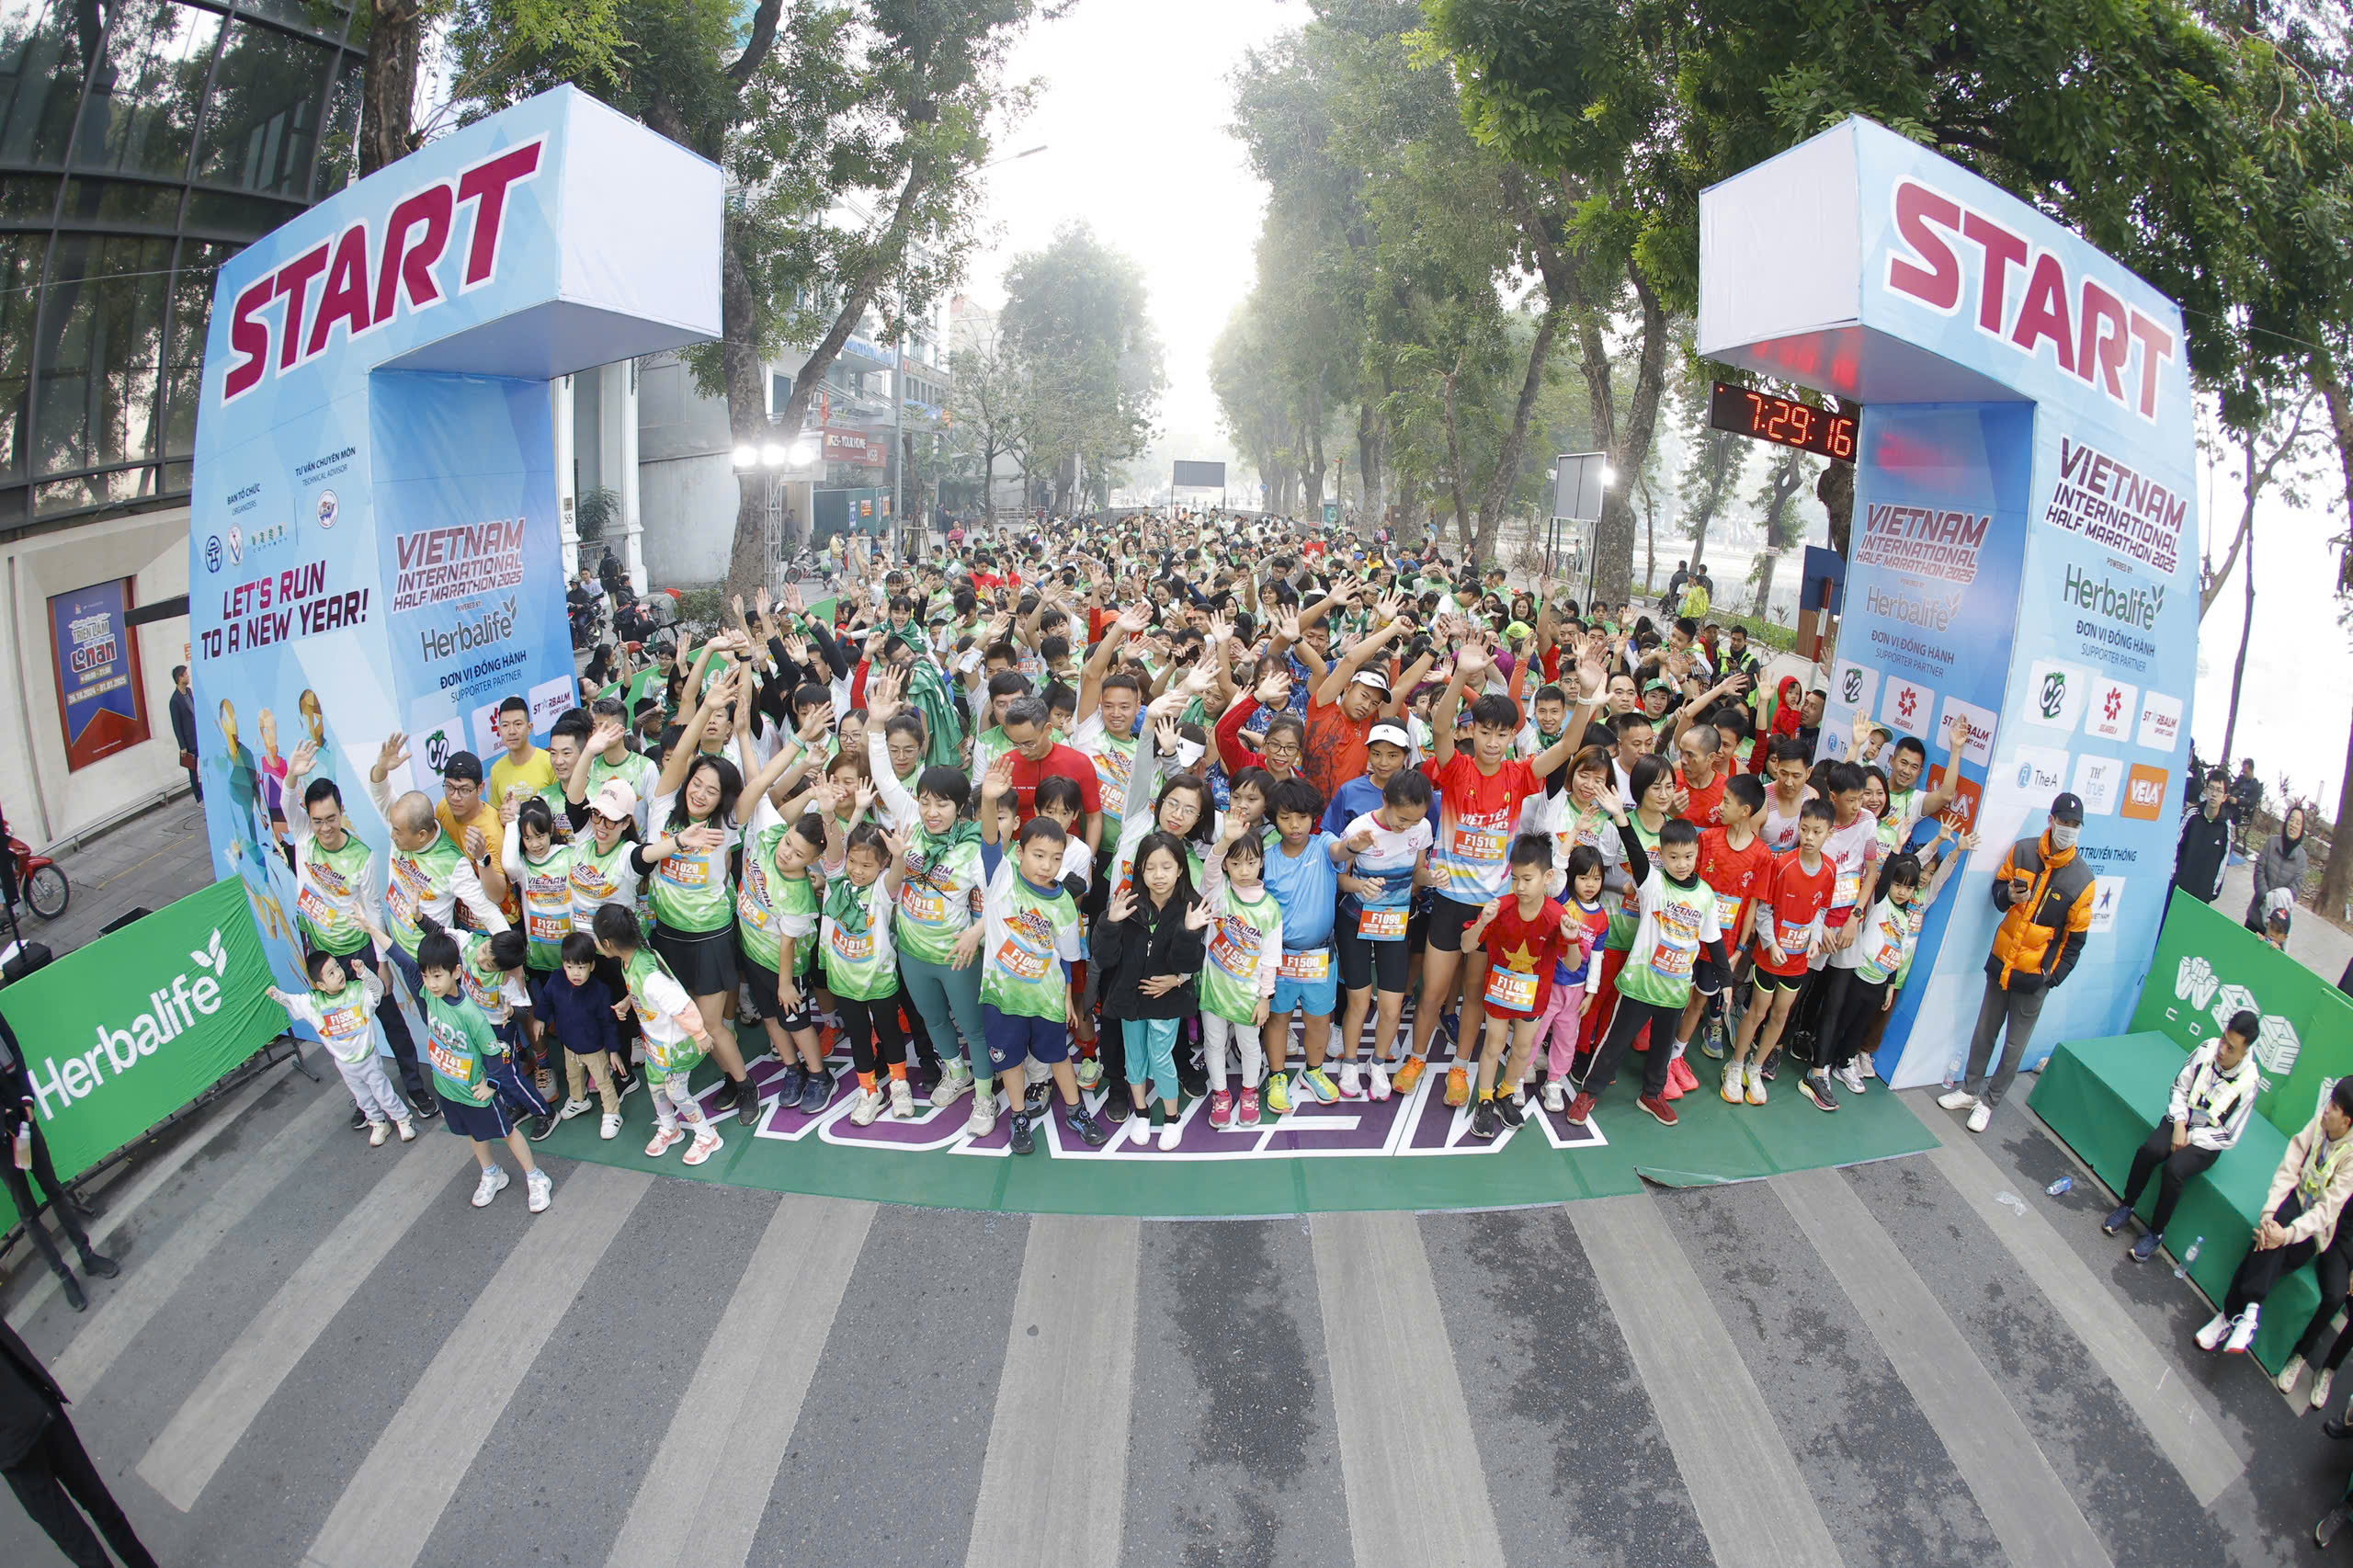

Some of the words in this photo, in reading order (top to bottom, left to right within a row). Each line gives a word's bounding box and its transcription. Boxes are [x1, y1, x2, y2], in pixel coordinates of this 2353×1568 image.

[222, 140, 543, 402] START
[1888, 180, 2174, 420] START
[1746, 393, 1852, 456] 7:29:16
[2061, 437, 2187, 533] VIETNAM
[1867, 504, 1989, 549] VIETNAM
[2046, 505, 2084, 532] HALF
[2085, 522, 2151, 563] MARATHON
[2151, 551, 2177, 574] 2025
[2053, 483, 2177, 557] INTERNATIONAL
[396, 517, 525, 570] VIETNAM
[1860, 534, 1977, 568] INTERNATIONAL
[397, 553, 522, 594] INTERNATIONAL
[1857, 551, 1882, 566] HALF
[1883, 556, 1945, 577] MARATHON
[1946, 566, 1974, 584] 2025
[223, 577, 272, 620] LET'S
[279, 560, 325, 604] RUN
[393, 589, 427, 611] HALF
[429, 577, 496, 602] MARATHON
[497, 570, 523, 587] 2025
[1867, 585, 1949, 632] Herbalife
[2063, 563, 2154, 631] Herbalife
[201, 628, 222, 660] TO
[228, 623, 240, 653] A
[246, 608, 292, 649] NEW
[299, 587, 369, 636] YEAR!
[421, 610, 512, 662] Herbalife
[1876, 647, 1912, 667] SUPPORTER
[1913, 658, 1944, 678] PARTNER
[2081, 643, 2120, 665] SUPPORTER
[2120, 653, 2146, 674] PARTNER
[451, 679, 492, 703] SUPPORTER
[493, 669, 522, 687] PARTNER
[2035, 769, 2050, 786] The
[2050, 774, 2058, 788] A
[2090, 767, 2101, 779] TH
[2131, 779, 2159, 806] VELA
[669, 859, 699, 873] F1029
[537, 918, 562, 929] F1271
[1370, 913, 1401, 925] F1099
[1010, 948, 1044, 970] F1000
[1287, 956, 1319, 968] F1500
[1496, 975, 1527, 994] F1145
[27, 972, 222, 1121] Herbalife
[427, 1011, 468, 1051] KIDS
